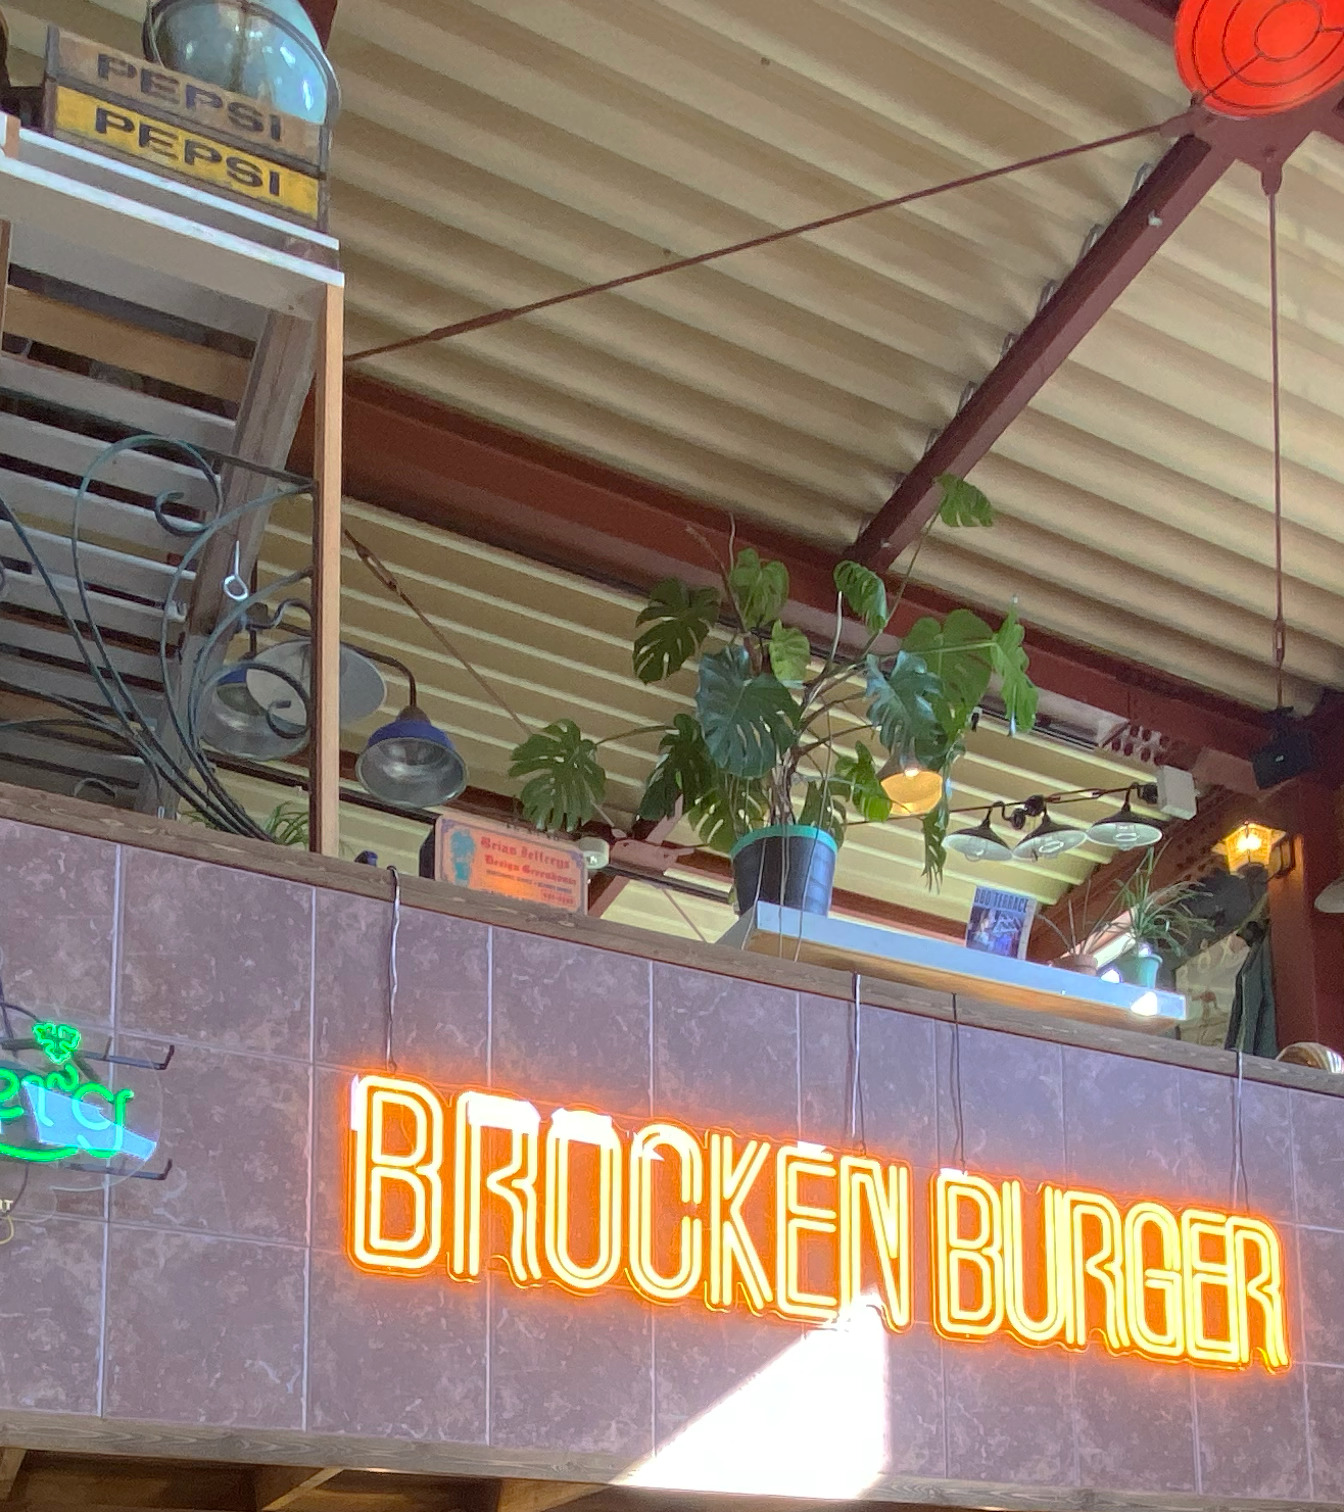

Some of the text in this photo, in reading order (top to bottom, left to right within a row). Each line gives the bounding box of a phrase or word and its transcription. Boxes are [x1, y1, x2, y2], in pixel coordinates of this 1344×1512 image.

[97, 53, 282, 142] PEPSI
[95, 107, 281, 197] PEPSI
[351, 1072, 1291, 1373] BROCKEN BURGER
